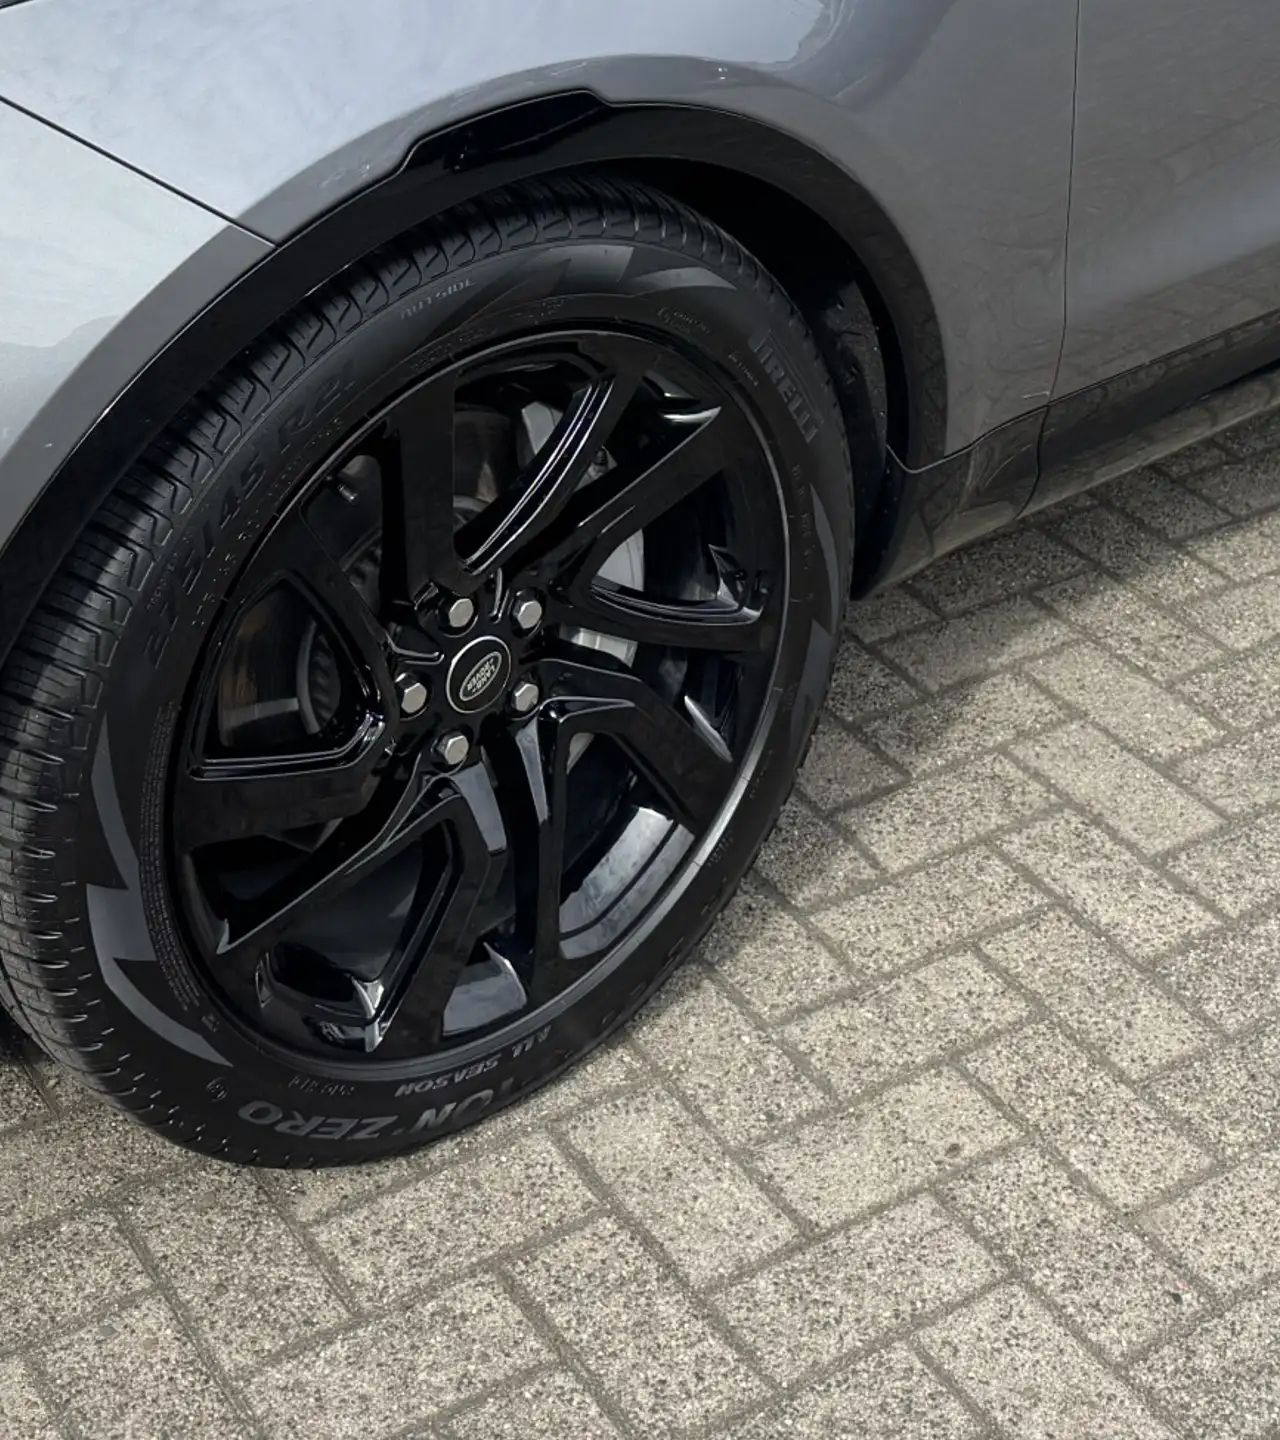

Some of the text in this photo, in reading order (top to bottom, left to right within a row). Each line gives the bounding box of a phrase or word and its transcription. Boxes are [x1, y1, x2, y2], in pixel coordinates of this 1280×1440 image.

[745, 326, 820, 446] PIRELLI
[393, 1053, 503, 1098] SEASON
[235, 1098, 400, 1143] ZERO
